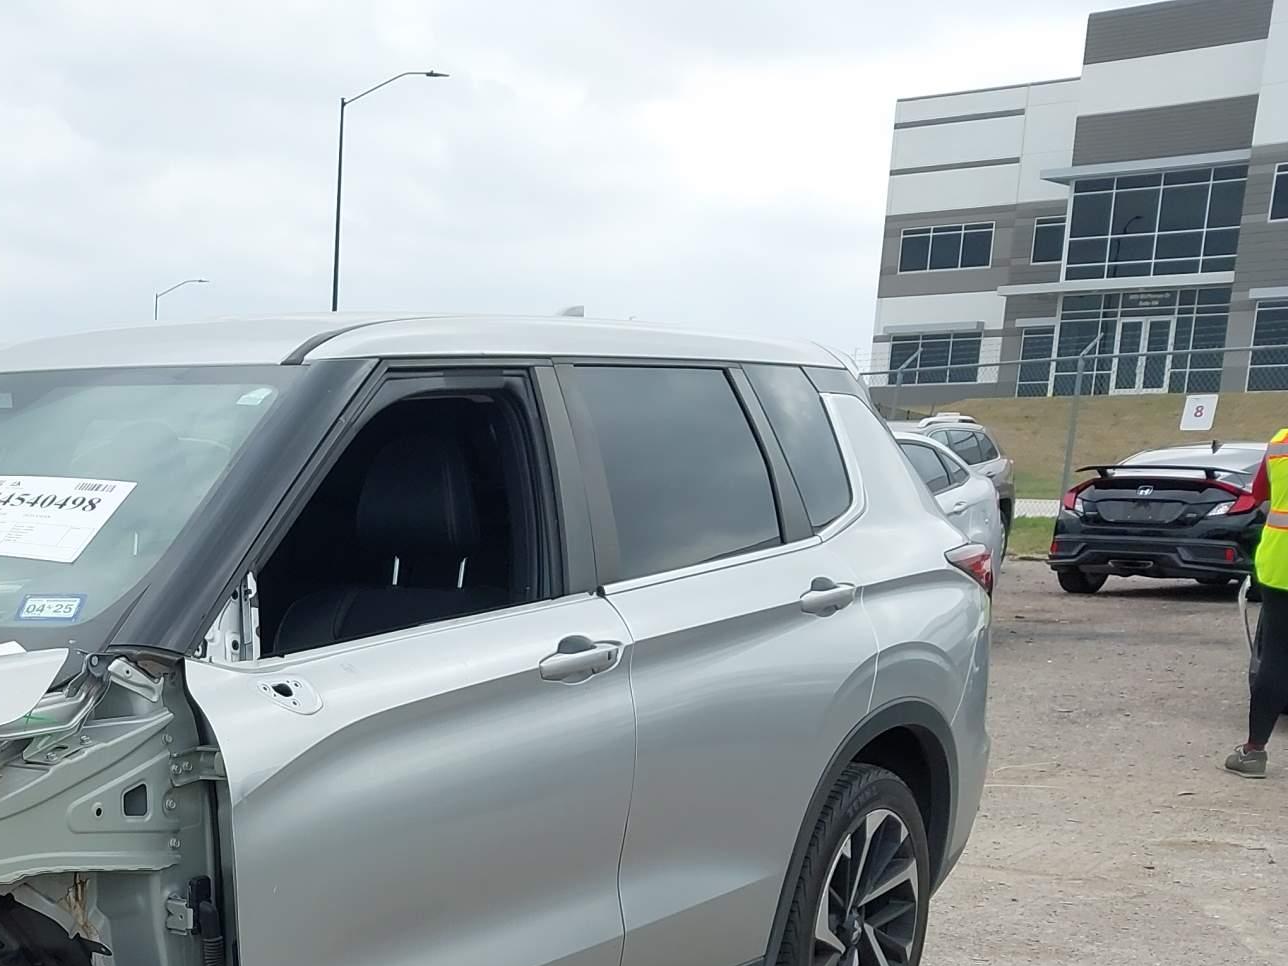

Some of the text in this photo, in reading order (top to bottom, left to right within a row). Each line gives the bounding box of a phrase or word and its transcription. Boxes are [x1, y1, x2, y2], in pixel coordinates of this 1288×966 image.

[1193, 405, 1205, 418] 8
[25, 603, 74, 614] 04 25
